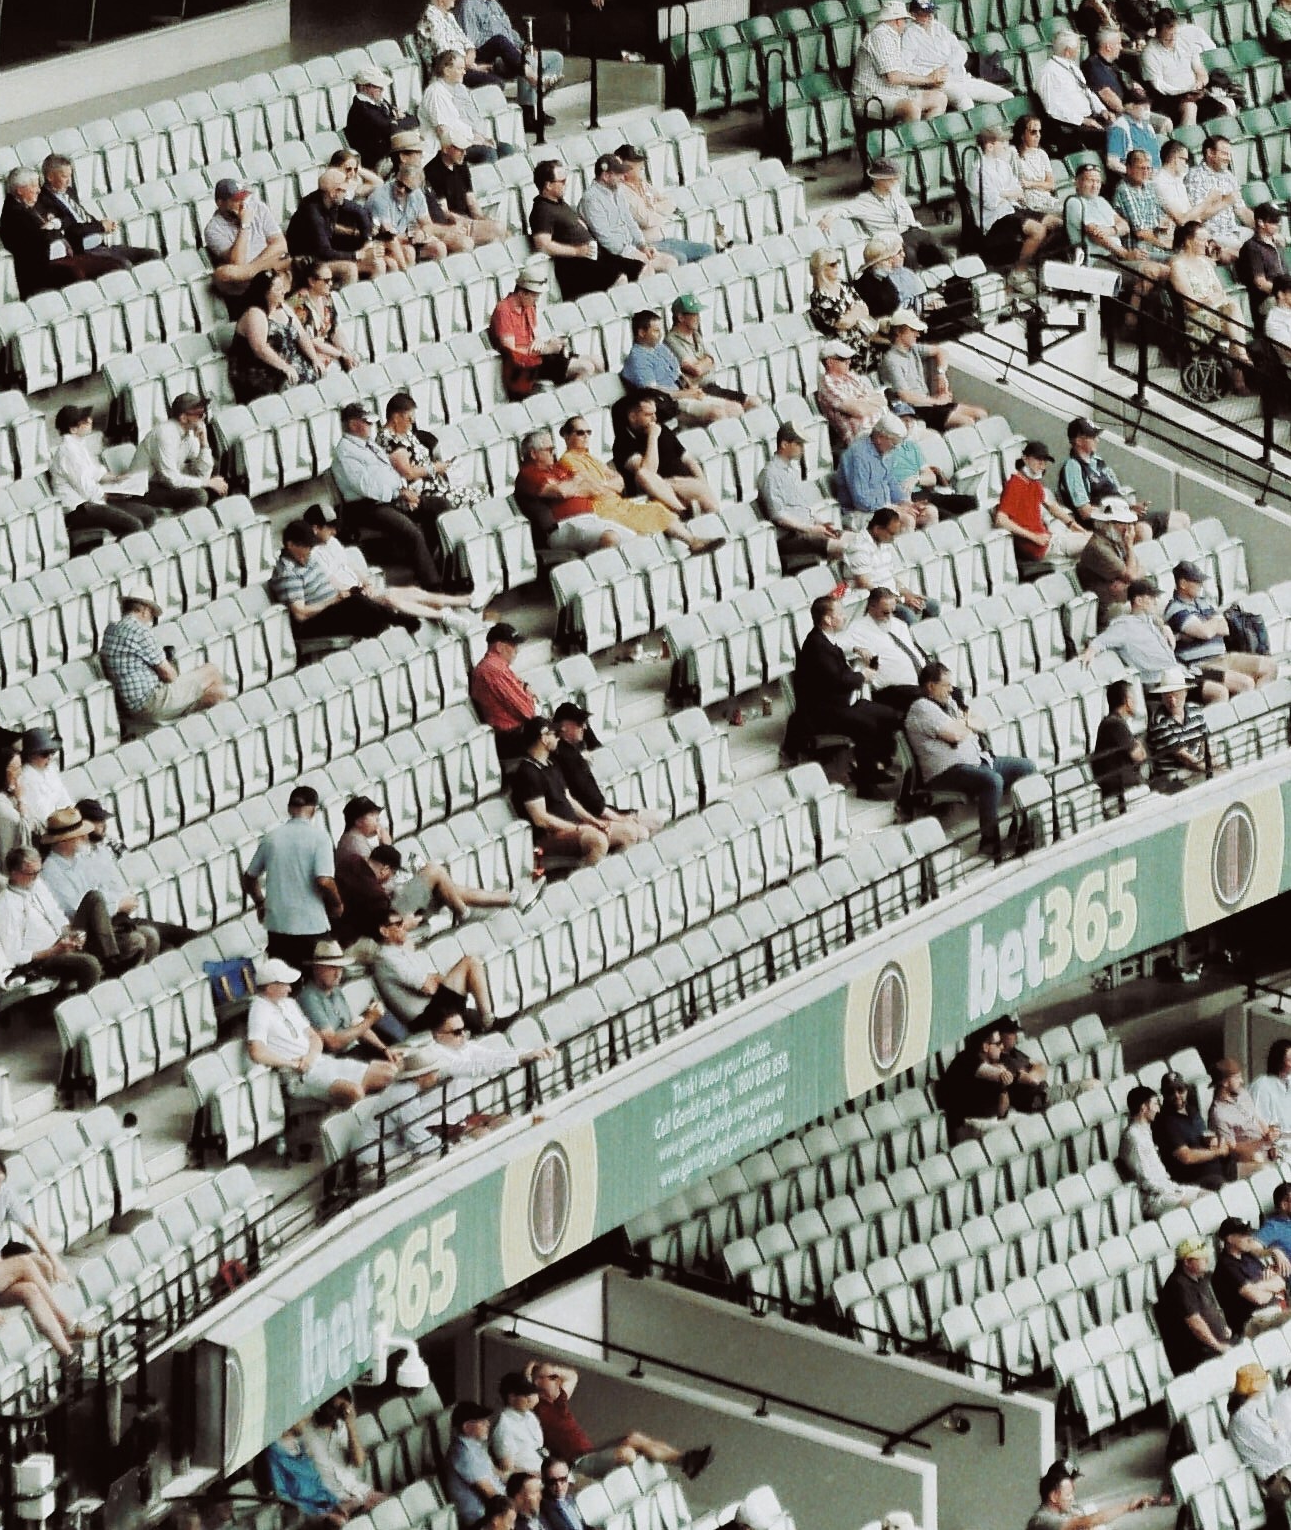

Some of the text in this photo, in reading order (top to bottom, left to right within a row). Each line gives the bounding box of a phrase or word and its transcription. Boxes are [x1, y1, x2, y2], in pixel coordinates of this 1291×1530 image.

[968, 856, 1138, 1022] bet365
[655, 1112, 671, 1140] Call
[300, 1209, 457, 1406] bet365
